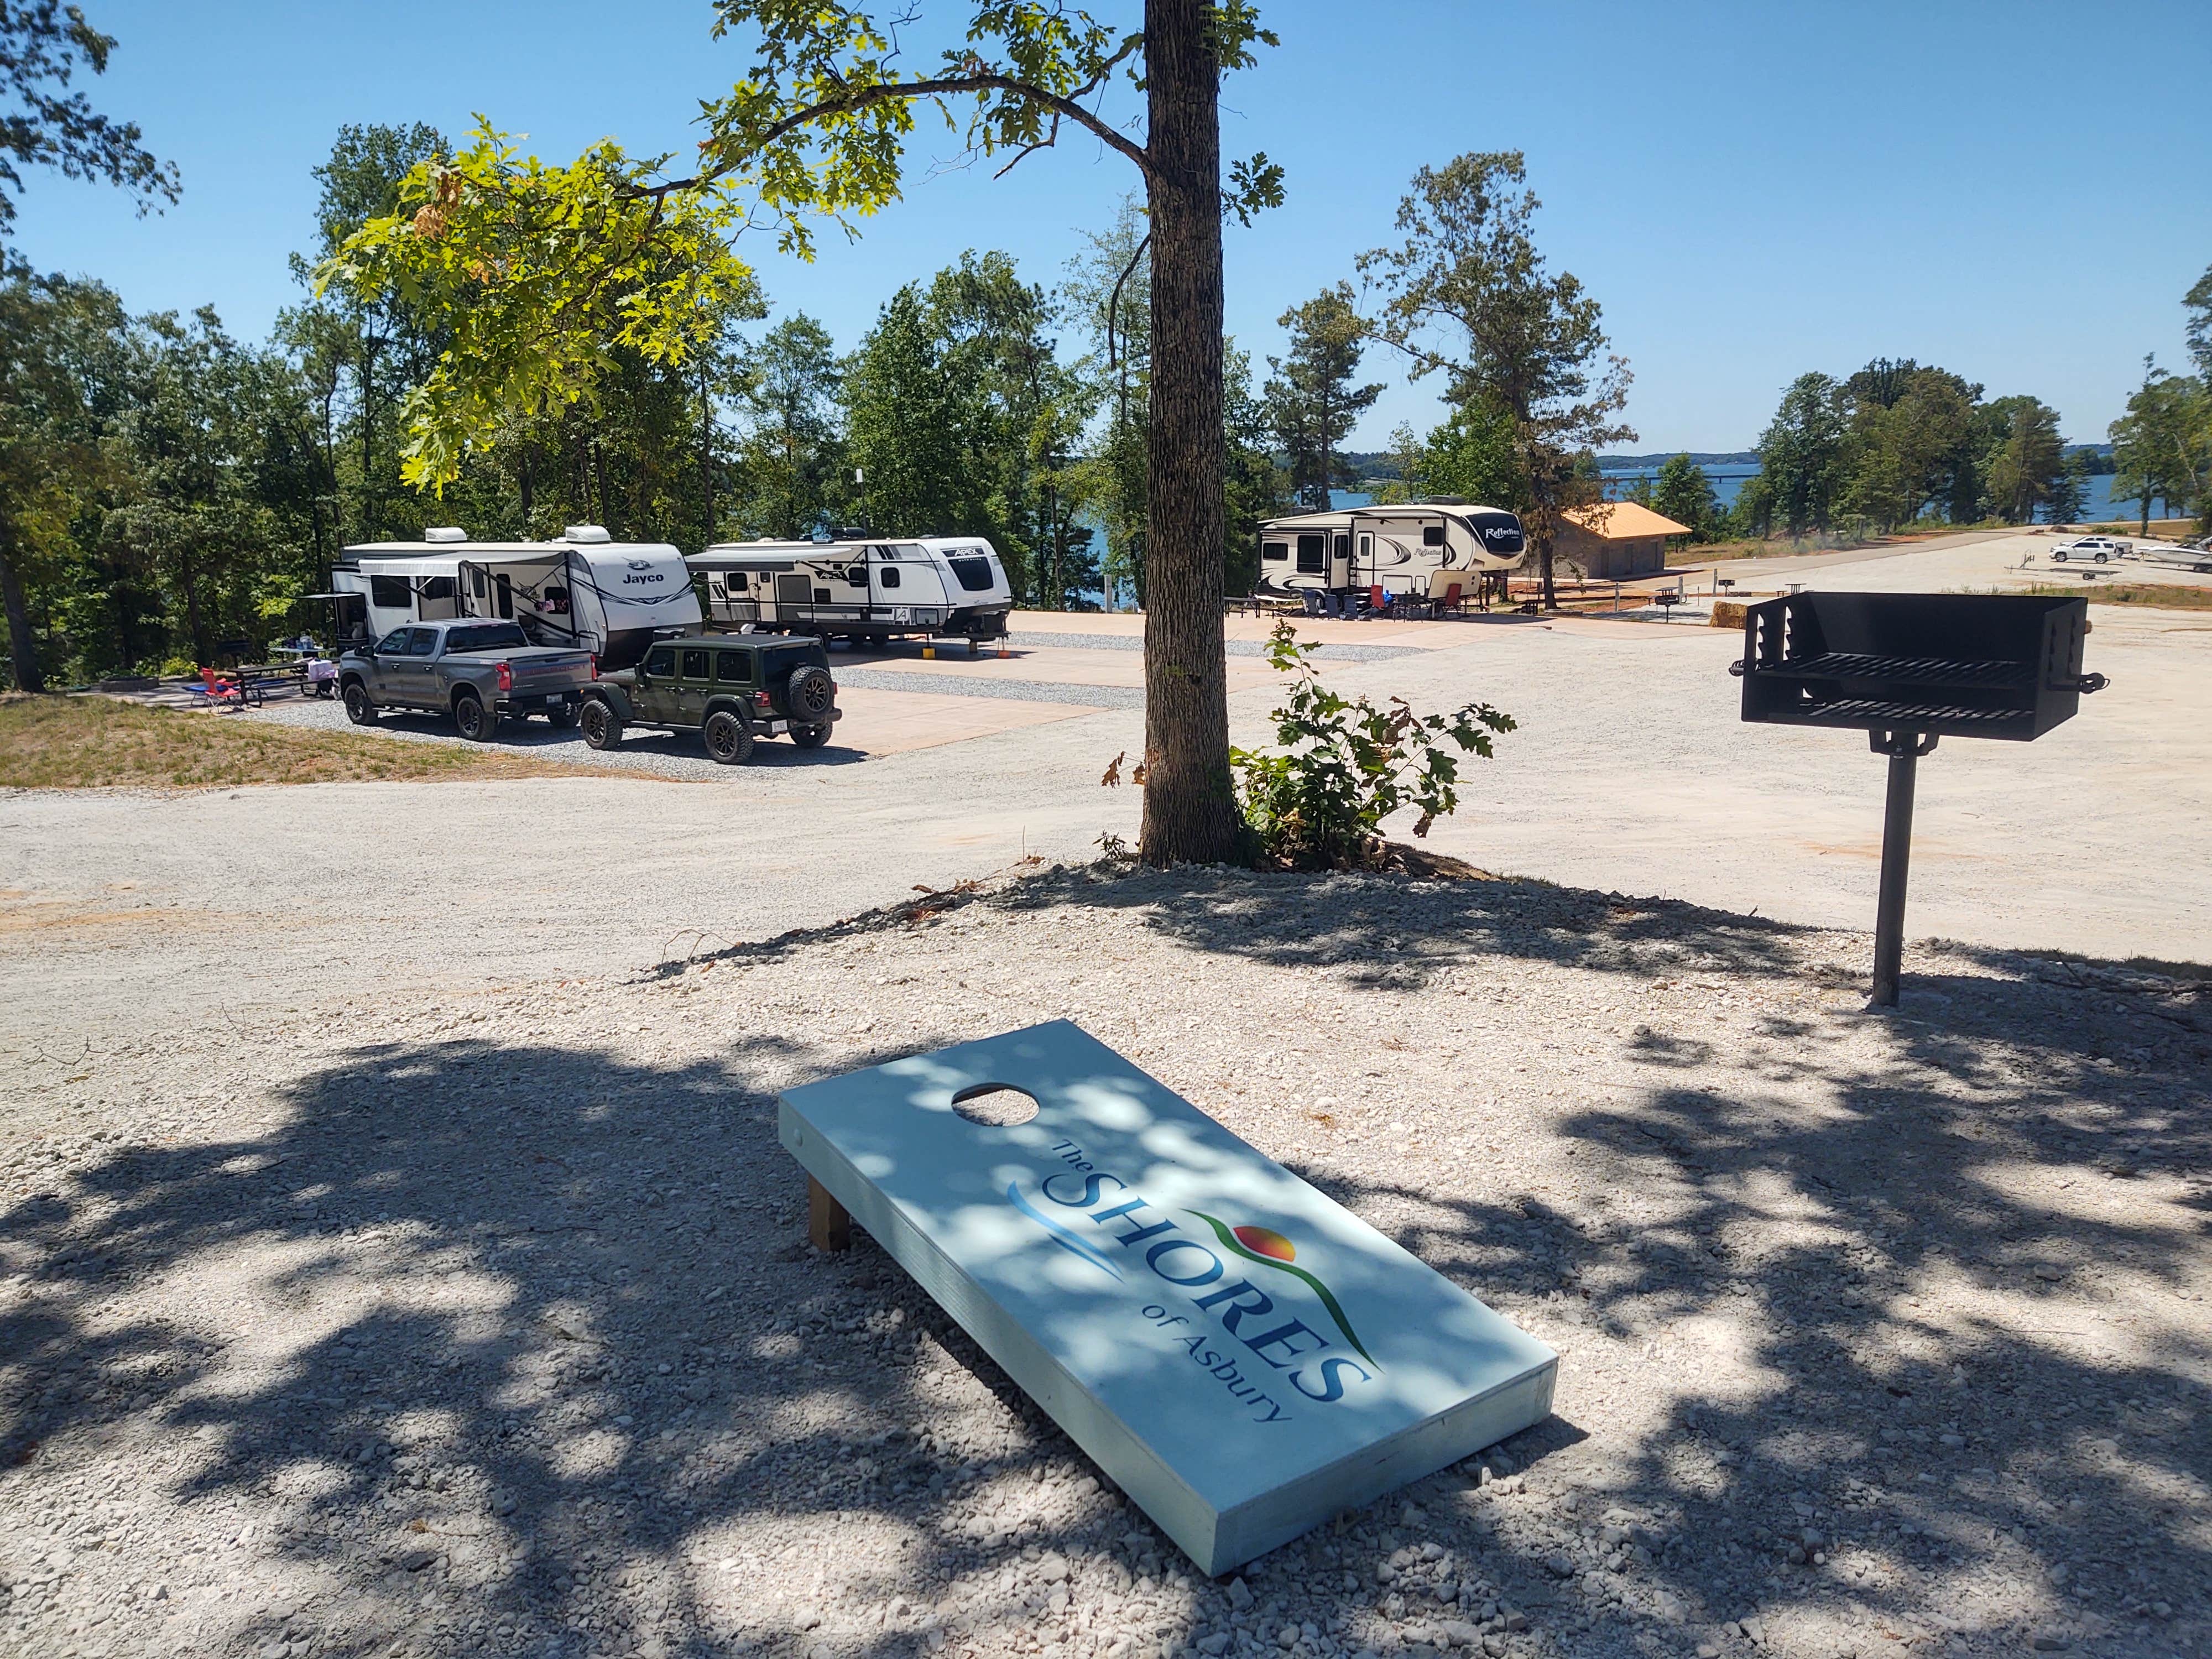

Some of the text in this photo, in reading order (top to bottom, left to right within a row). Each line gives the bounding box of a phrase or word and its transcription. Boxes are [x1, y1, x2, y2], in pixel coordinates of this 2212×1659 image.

[1485, 528, 1520, 539] Reflection
[954, 548, 978, 557] APEX
[623, 574, 664, 585] Jayco
[1052, 1139, 1093, 1172] The
[1041, 1172, 1372, 1402] SHORES
[1142, 1305, 1293, 1423] of Asbury
